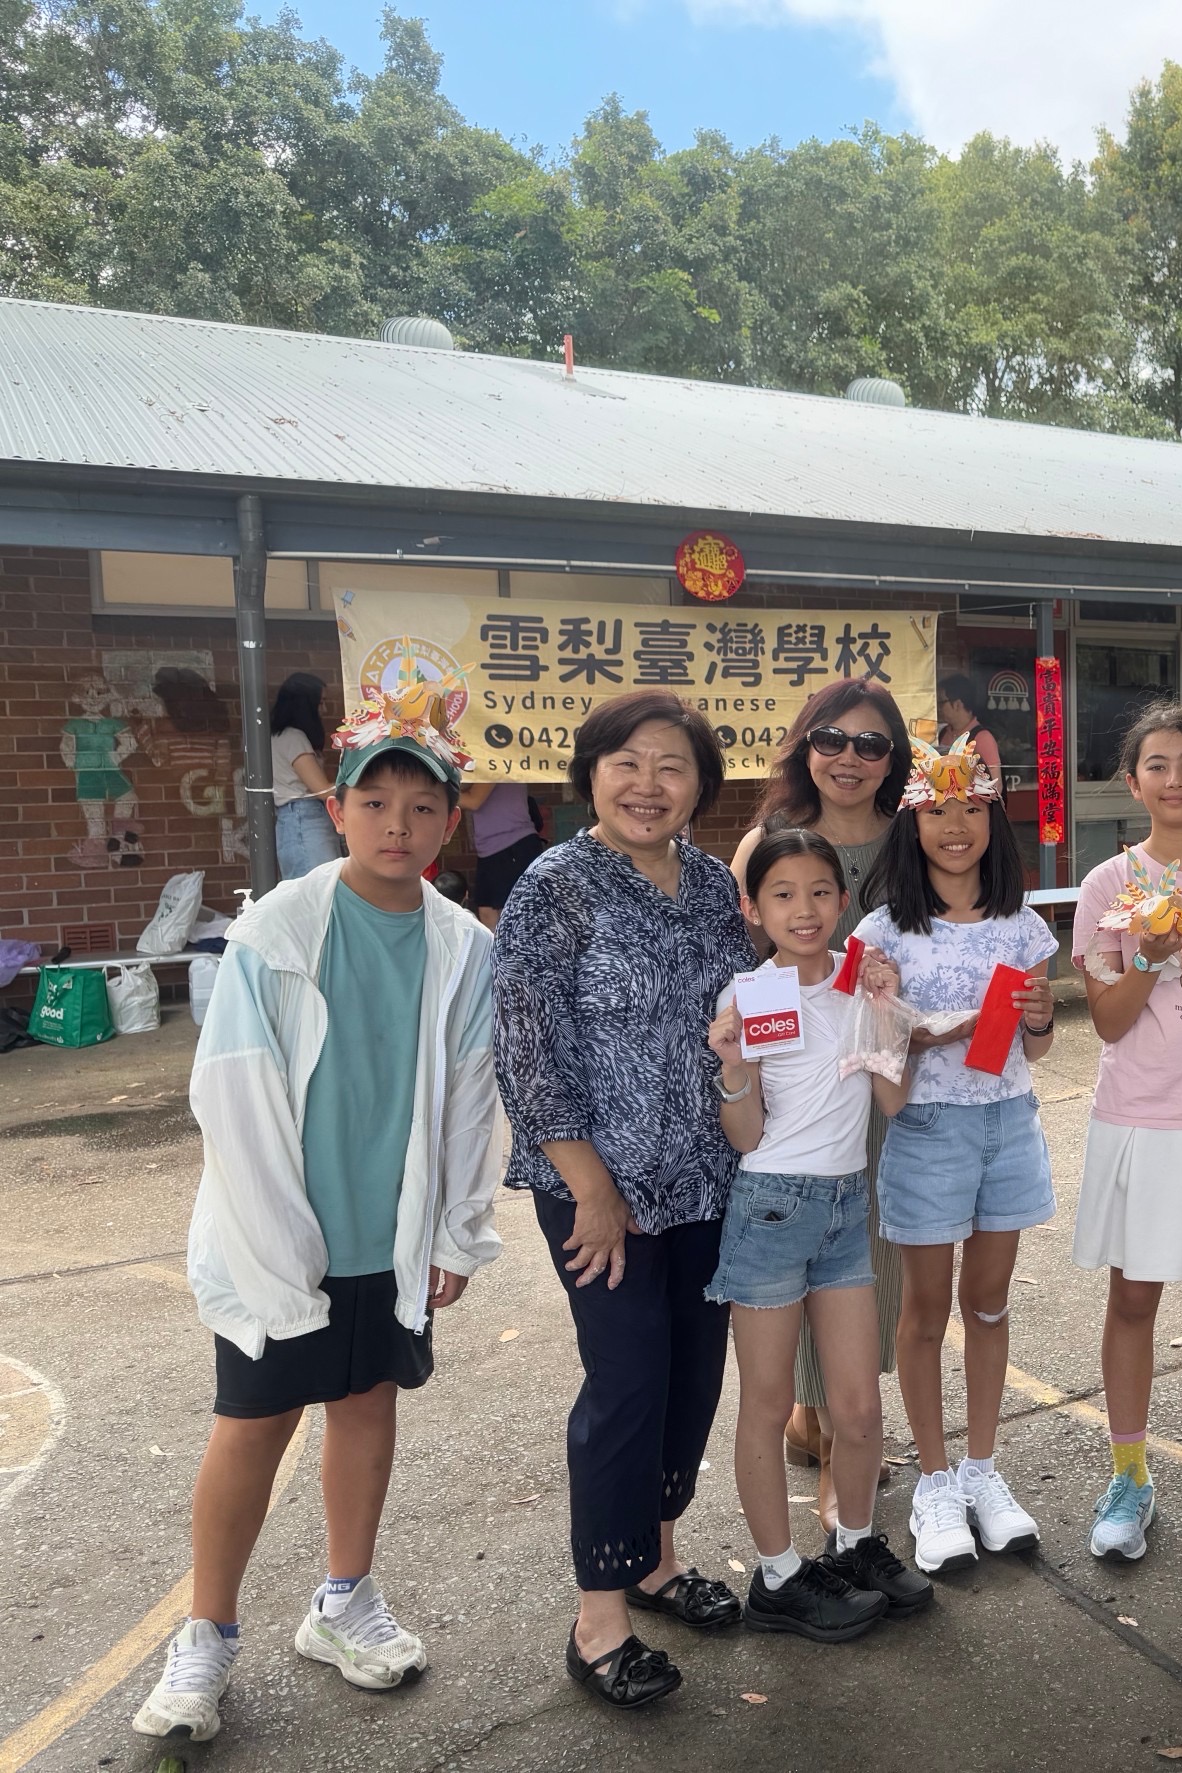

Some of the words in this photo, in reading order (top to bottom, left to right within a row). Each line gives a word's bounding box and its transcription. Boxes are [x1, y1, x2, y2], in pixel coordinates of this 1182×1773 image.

[480, 614, 891, 687] 雪梨臺灣學校
[483, 690, 592, 714] Sydney
[682, 697, 776, 711] anese
[1039, 669, 1062, 823] 富貴平安福滿堂
[40, 1006, 64, 1020] good
[749, 1018, 795, 1036] coles
